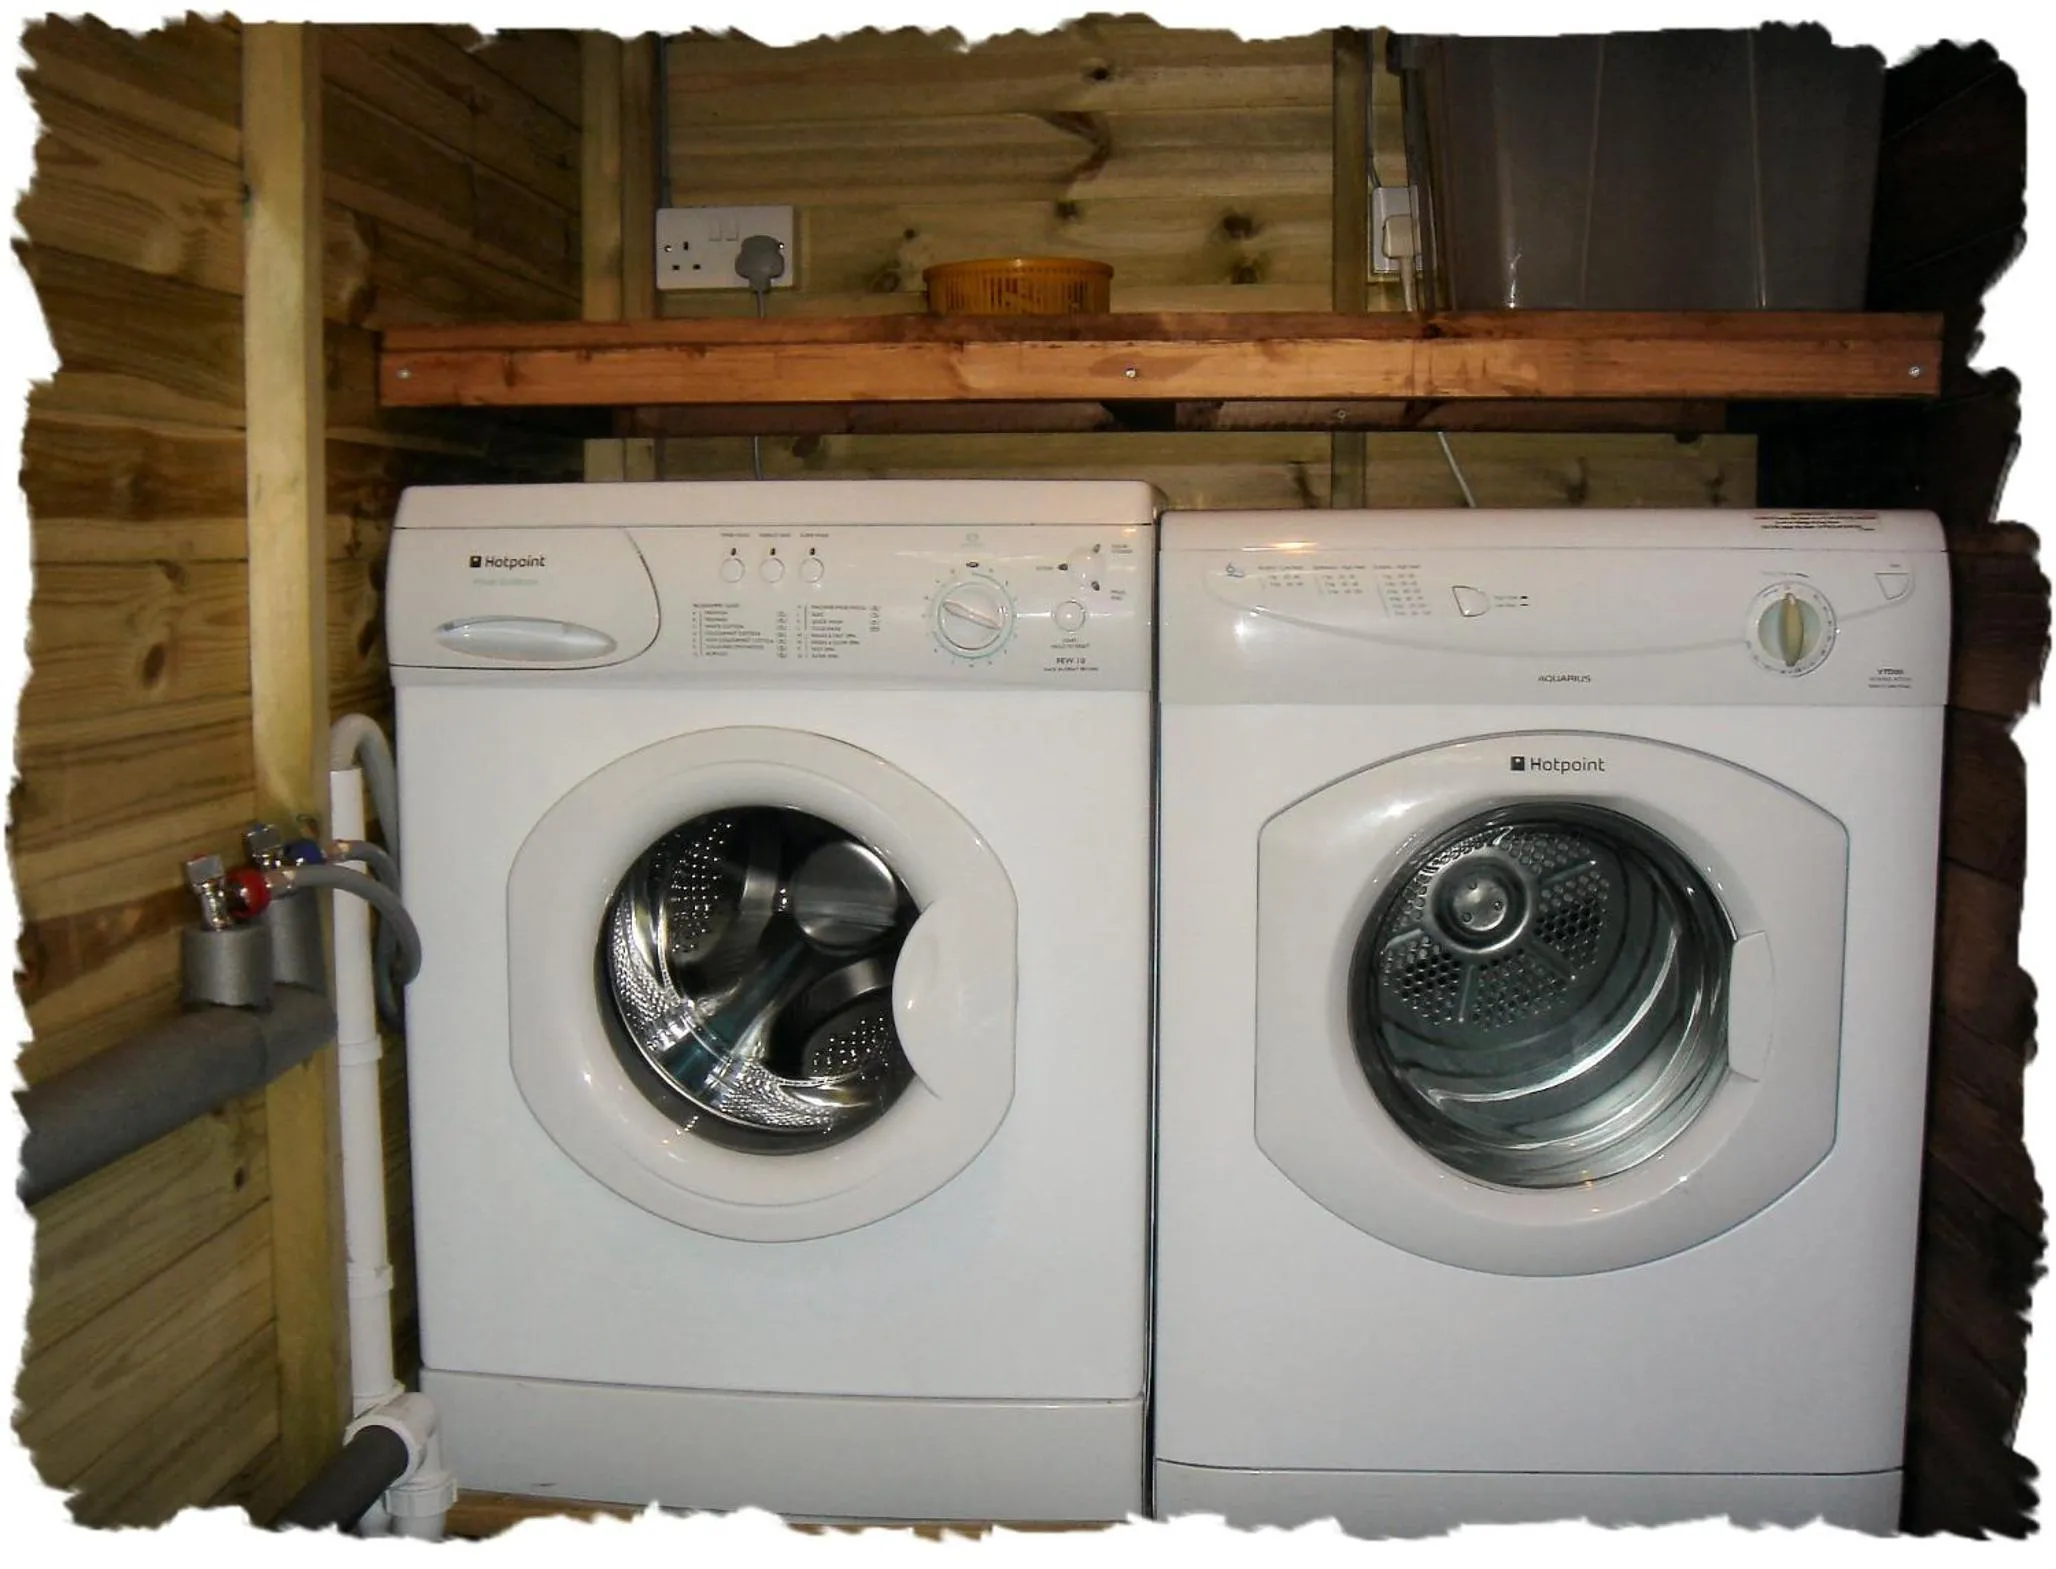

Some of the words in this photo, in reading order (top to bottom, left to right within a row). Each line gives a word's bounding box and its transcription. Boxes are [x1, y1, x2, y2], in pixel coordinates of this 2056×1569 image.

[485, 555, 546, 570] Hotpoint
[1538, 674, 1591, 683] AQUARIUS
[1530, 756, 1605, 774] Hotpoint
